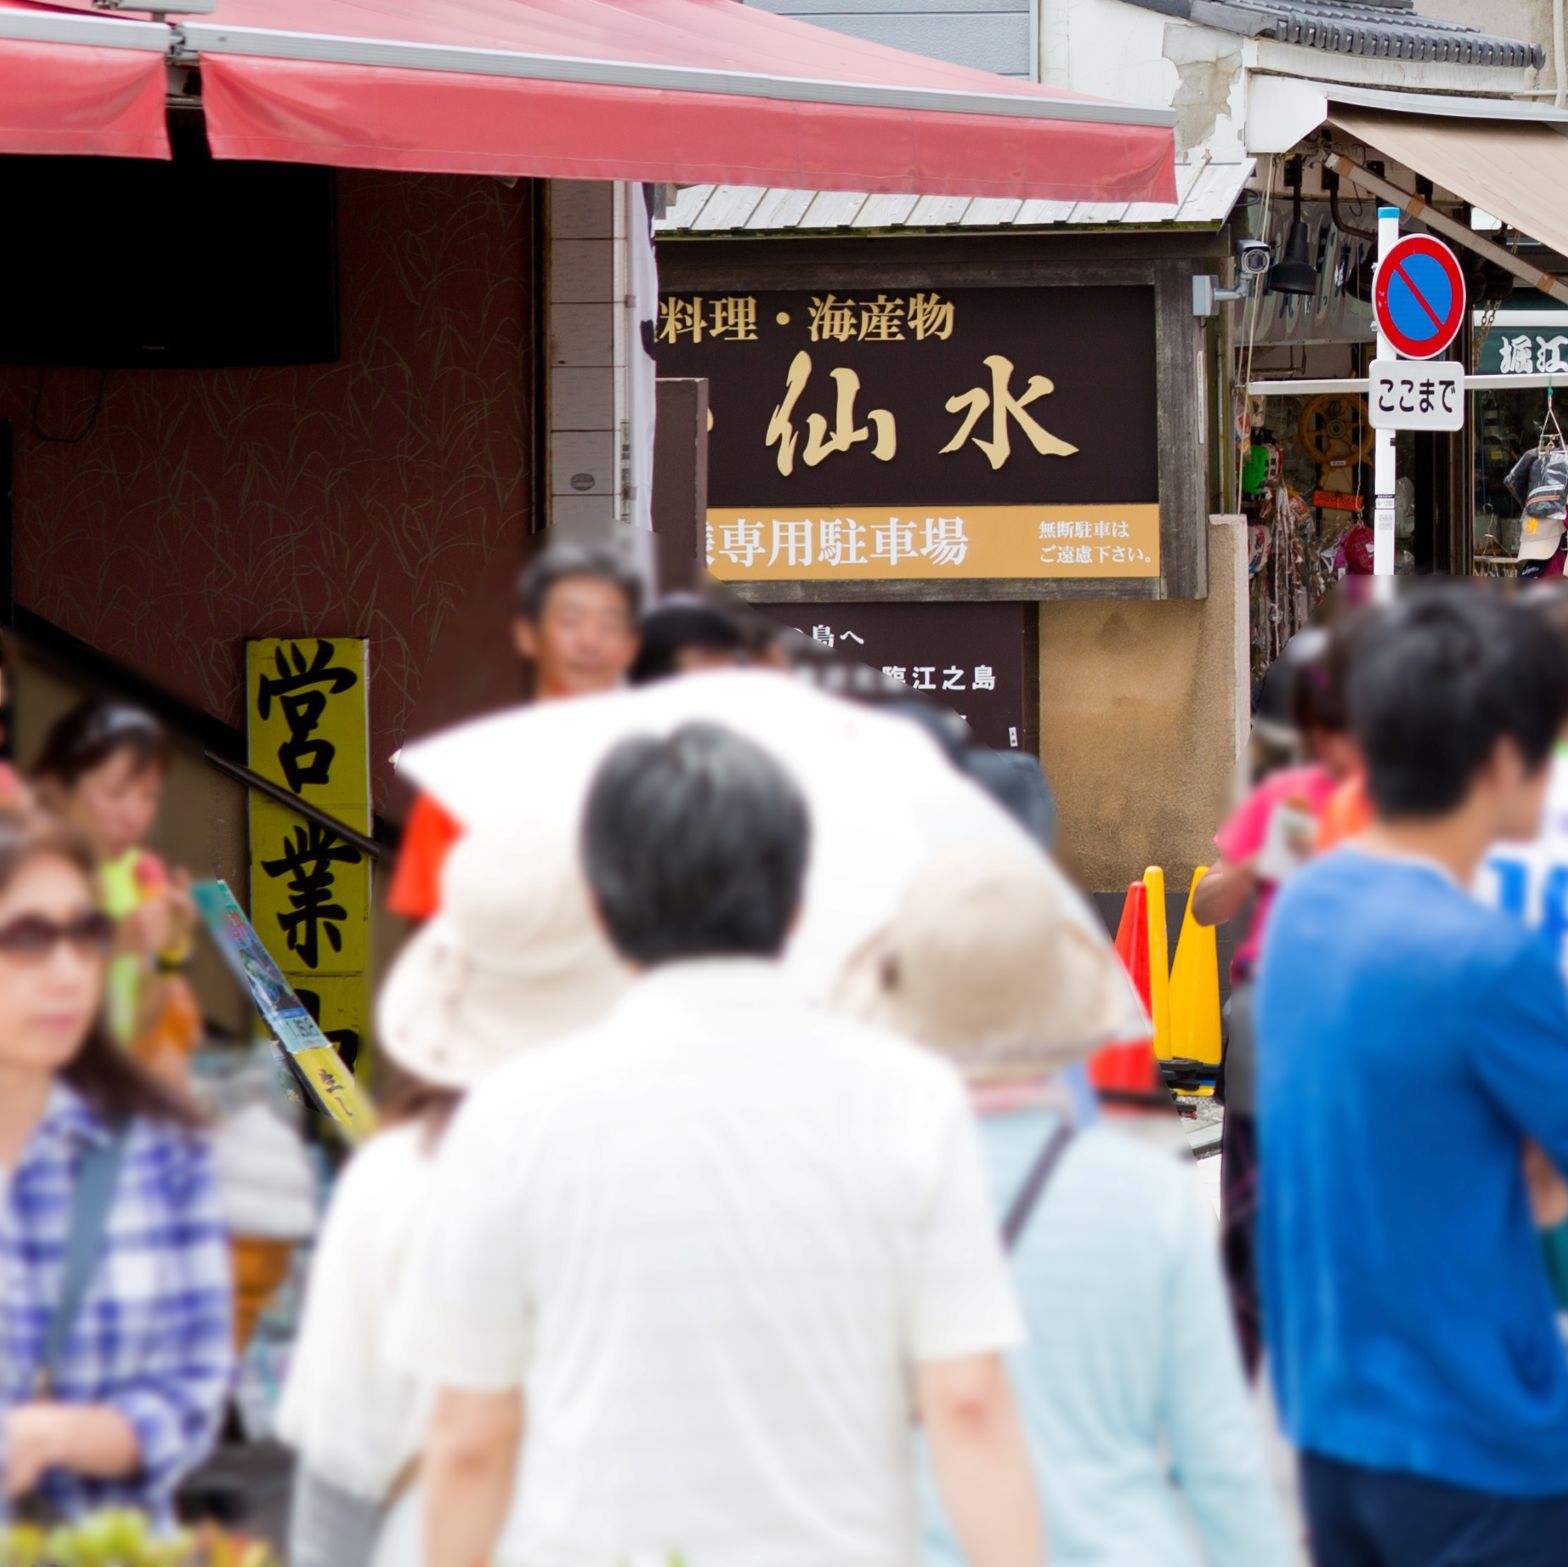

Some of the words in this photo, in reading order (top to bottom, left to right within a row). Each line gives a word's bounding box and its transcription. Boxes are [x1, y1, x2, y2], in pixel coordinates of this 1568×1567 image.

[655, 293, 955, 344] 料理・海産物
[1378, 378, 1456, 415] ここまで
[1038, 520, 1129, 541] 無断駐車は
[795, 624, 865, 649] 島へ
